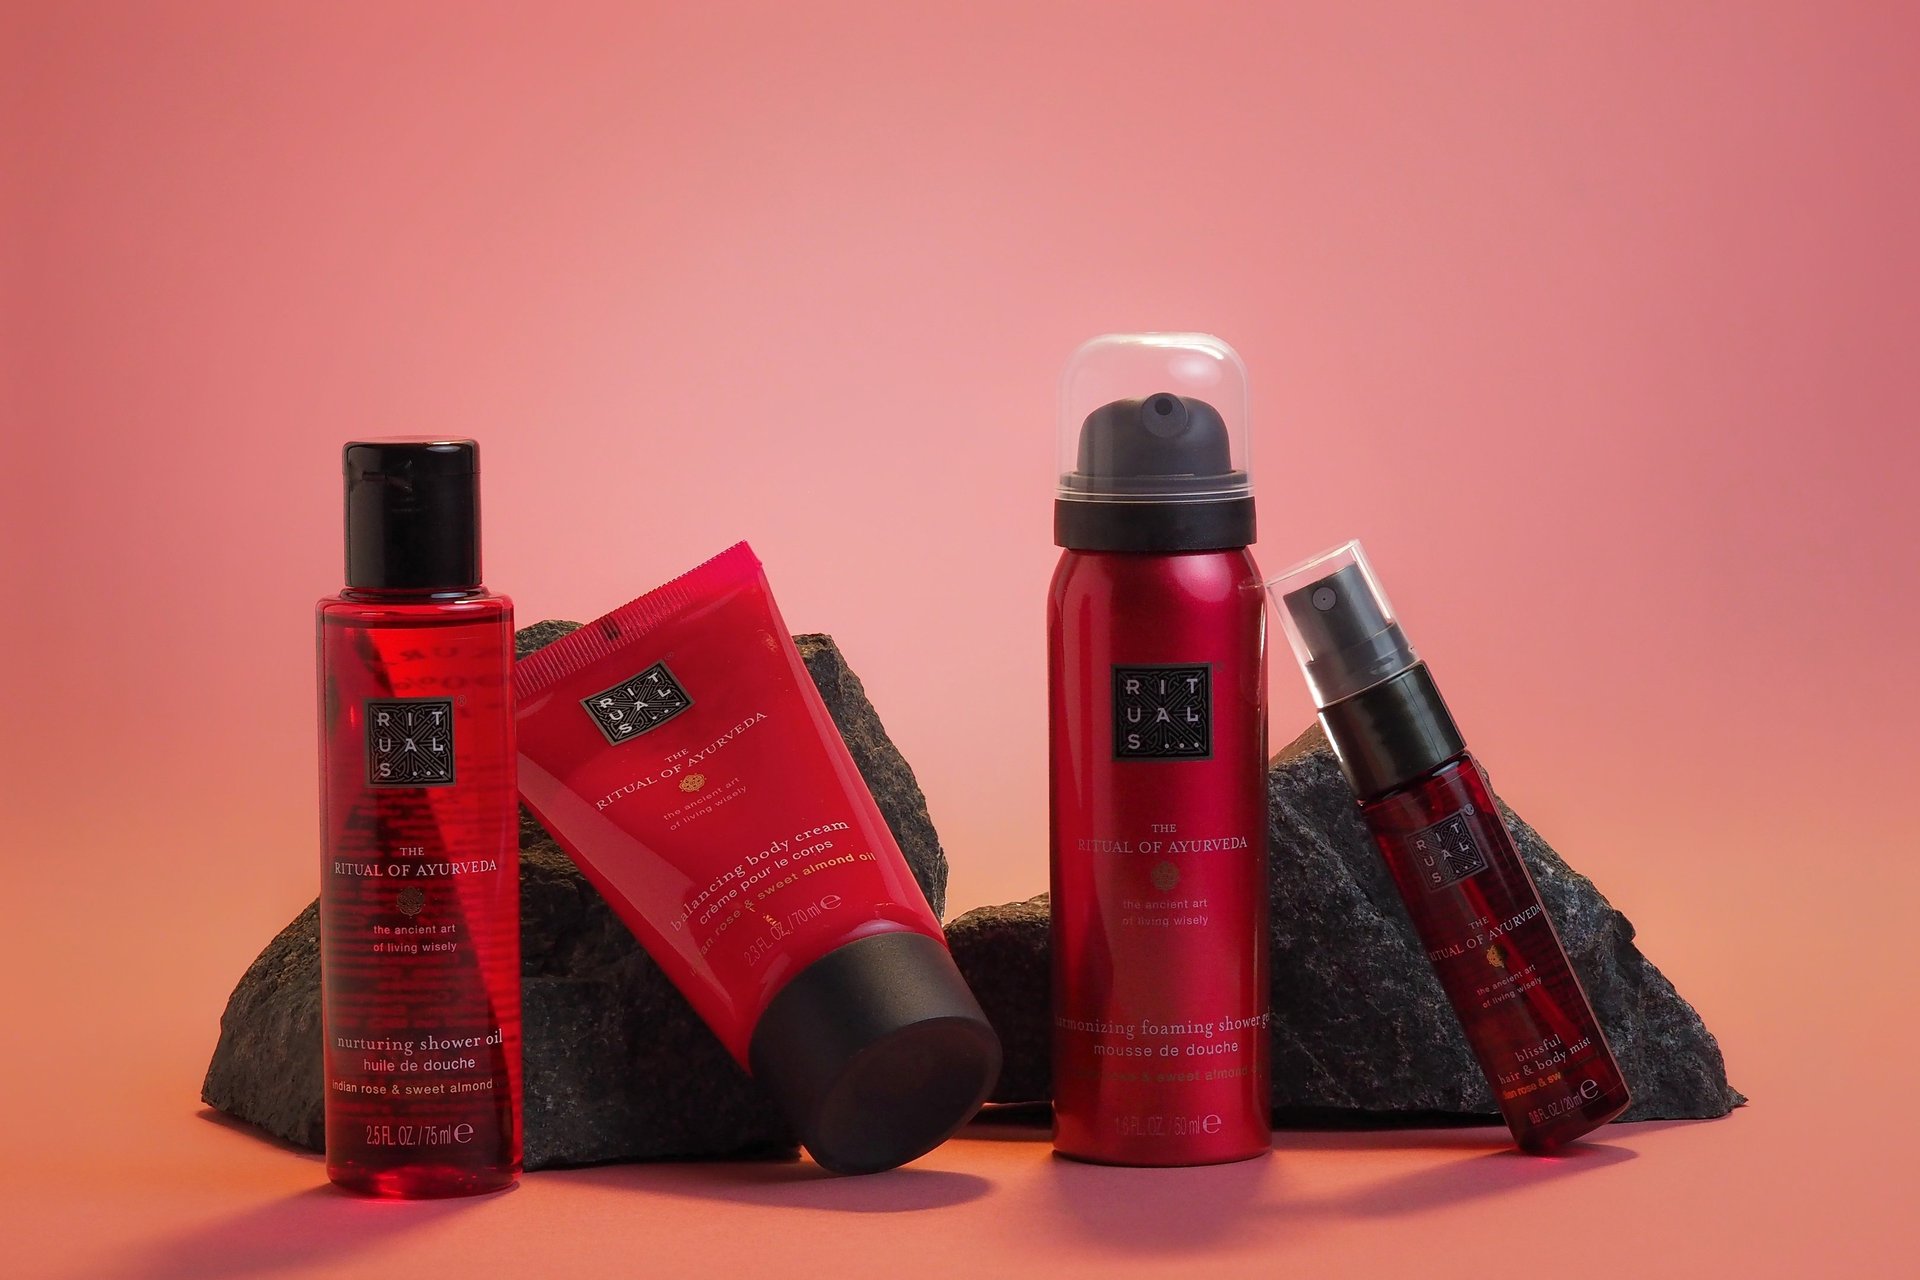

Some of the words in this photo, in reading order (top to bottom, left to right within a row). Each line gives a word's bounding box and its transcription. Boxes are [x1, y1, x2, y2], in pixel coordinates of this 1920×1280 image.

[596, 776, 658, 811] RITUAL
[660, 764, 682, 778] OF
[687, 712, 768, 767] AYURVEDA
[664, 748, 689, 763] THE
[663, 808, 681, 821] the
[684, 787, 723, 810] ancient
[725, 777, 740, 788] art
[670, 821, 681, 831] of
[683, 806, 713, 824] living
[714, 786, 747, 806] wisely
[1152, 824, 1177, 833] THE
[400, 847, 425, 856] THE
[1078, 838, 1133, 853] RITUAL
[1139, 842, 1162, 853] OF
[1168, 836, 1248, 853] AYURVEDA
[335, 862, 383, 877] RITUAL
[388, 865, 411, 876] OF
[416, 859, 497, 876] AYURVEDA
[670, 864, 744, 932] balancing
[745, 839, 789, 866] body
[795, 820, 849, 842] cream
[699, 888, 739, 926] crème
[740, 866, 772, 893] pour
[774, 857, 789, 869] le
[792, 840, 833, 861] corps
[715, 910, 741, 936] rose
[744, 900, 754, 912] &
[757, 872, 798, 901] sweet
[802, 853, 855, 876] almond
[859, 852, 876, 862] oil
[1122, 899, 1141, 909] the
[1145, 899, 1188, 909] ancient
[1192, 899, 1208, 908] art
[792, 909, 808, 925] 70
[806, 902, 822, 918] ml
[1122, 916, 1133, 926] of
[1173, 915, 1209, 926] wisely
[1468, 916, 1490, 930] THE
[374, 925, 391, 935] the
[394, 925, 436, 935] ancient
[440, 925, 456, 934] art
[1466, 934, 1484, 949] OF
[1489, 903, 1542, 940] AYURVEDA
[374, 942, 384, 952] of
[388, 942, 418, 954] living
[422, 941, 457, 952] wisely
[1476, 984, 1490, 996] the
[1492, 972, 1523, 990] ancient
[1524, 964, 1537, 976] art
[1482, 1000, 1491, 1009] of
[1492, 989, 1516, 1006] living
[1517, 976, 1543, 994] wisely
[1142, 1019, 1213, 1039] foaming
[1218, 1015, 1260, 1032] shower
[337, 1036, 414, 1056] nurturing
[420, 1035, 480, 1050] shower
[486, 1028, 503, 1045] oil
[1093, 1044, 1152, 1057] mousse
[1160, 1045, 1179, 1057] de
[1186, 1041, 1239, 1057] douche
[1514, 1033, 1562, 1063] blissful
[363, 1058, 395, 1072] huile
[400, 1059, 418, 1072] de
[423, 1057, 476, 1071] douche
[1497, 1072, 1520, 1085] hair
[1523, 1064, 1534, 1076] &
[1535, 1050, 1566, 1071] body
[1569, 1036, 1592, 1055] mist
[1205, 1066, 1248, 1081] almond
[332, 1079, 357, 1093] indian
[361, 1085, 387, 1094] rose
[391, 1084, 400, 1095] &
[405, 1084, 445, 1094] sweet
[450, 1078, 493, 1094] almond
[1563, 1096, 1575, 1110] 20
[366, 1125, 380, 1145] 2.5
[425, 1126, 438, 1145] 75
[439, 1124, 451, 1145] ml
[1189, 1115, 1200, 1135] ml
